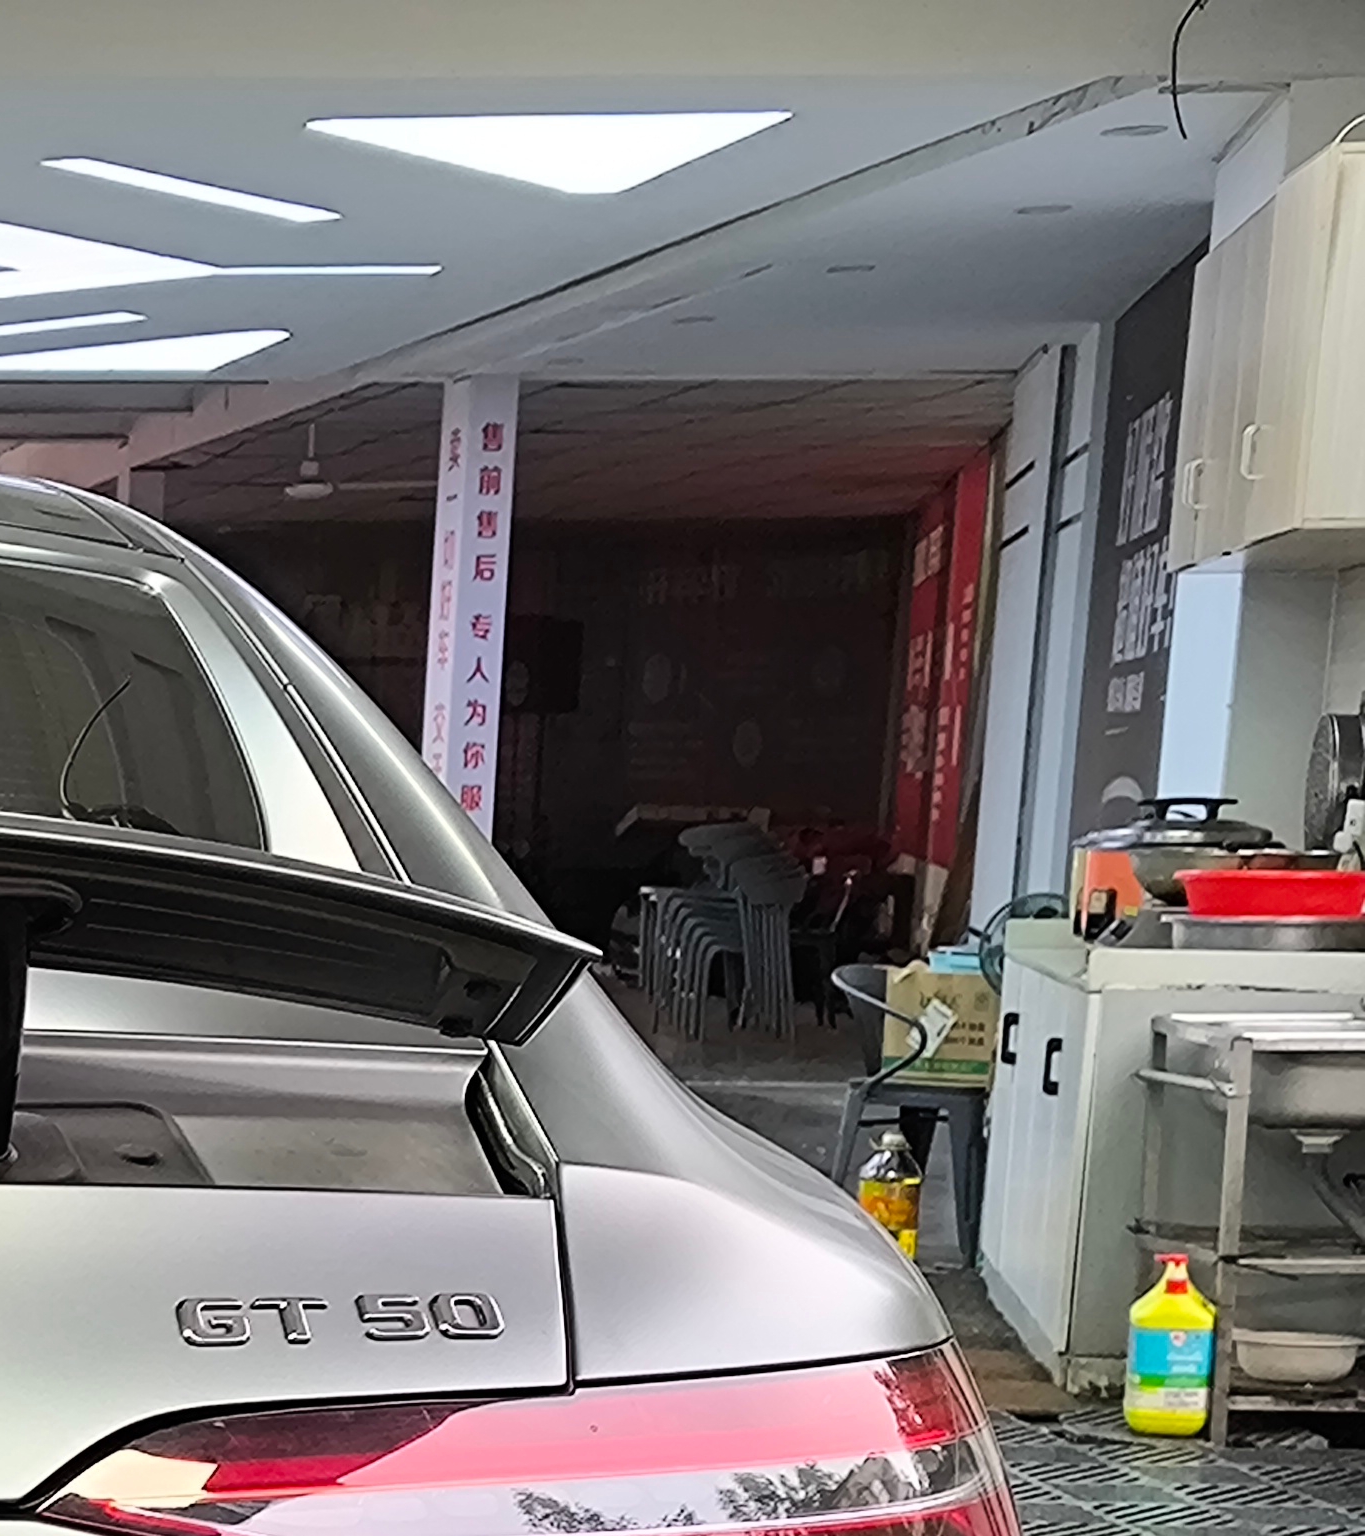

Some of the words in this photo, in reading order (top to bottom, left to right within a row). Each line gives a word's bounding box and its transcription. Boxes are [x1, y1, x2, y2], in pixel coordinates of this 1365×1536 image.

[472, 421, 506, 582] 售前售后
[460, 612, 492, 811] 专人为你服
[175, 1297, 330, 1347] GT
[354, 1293, 506, 1341] 50
